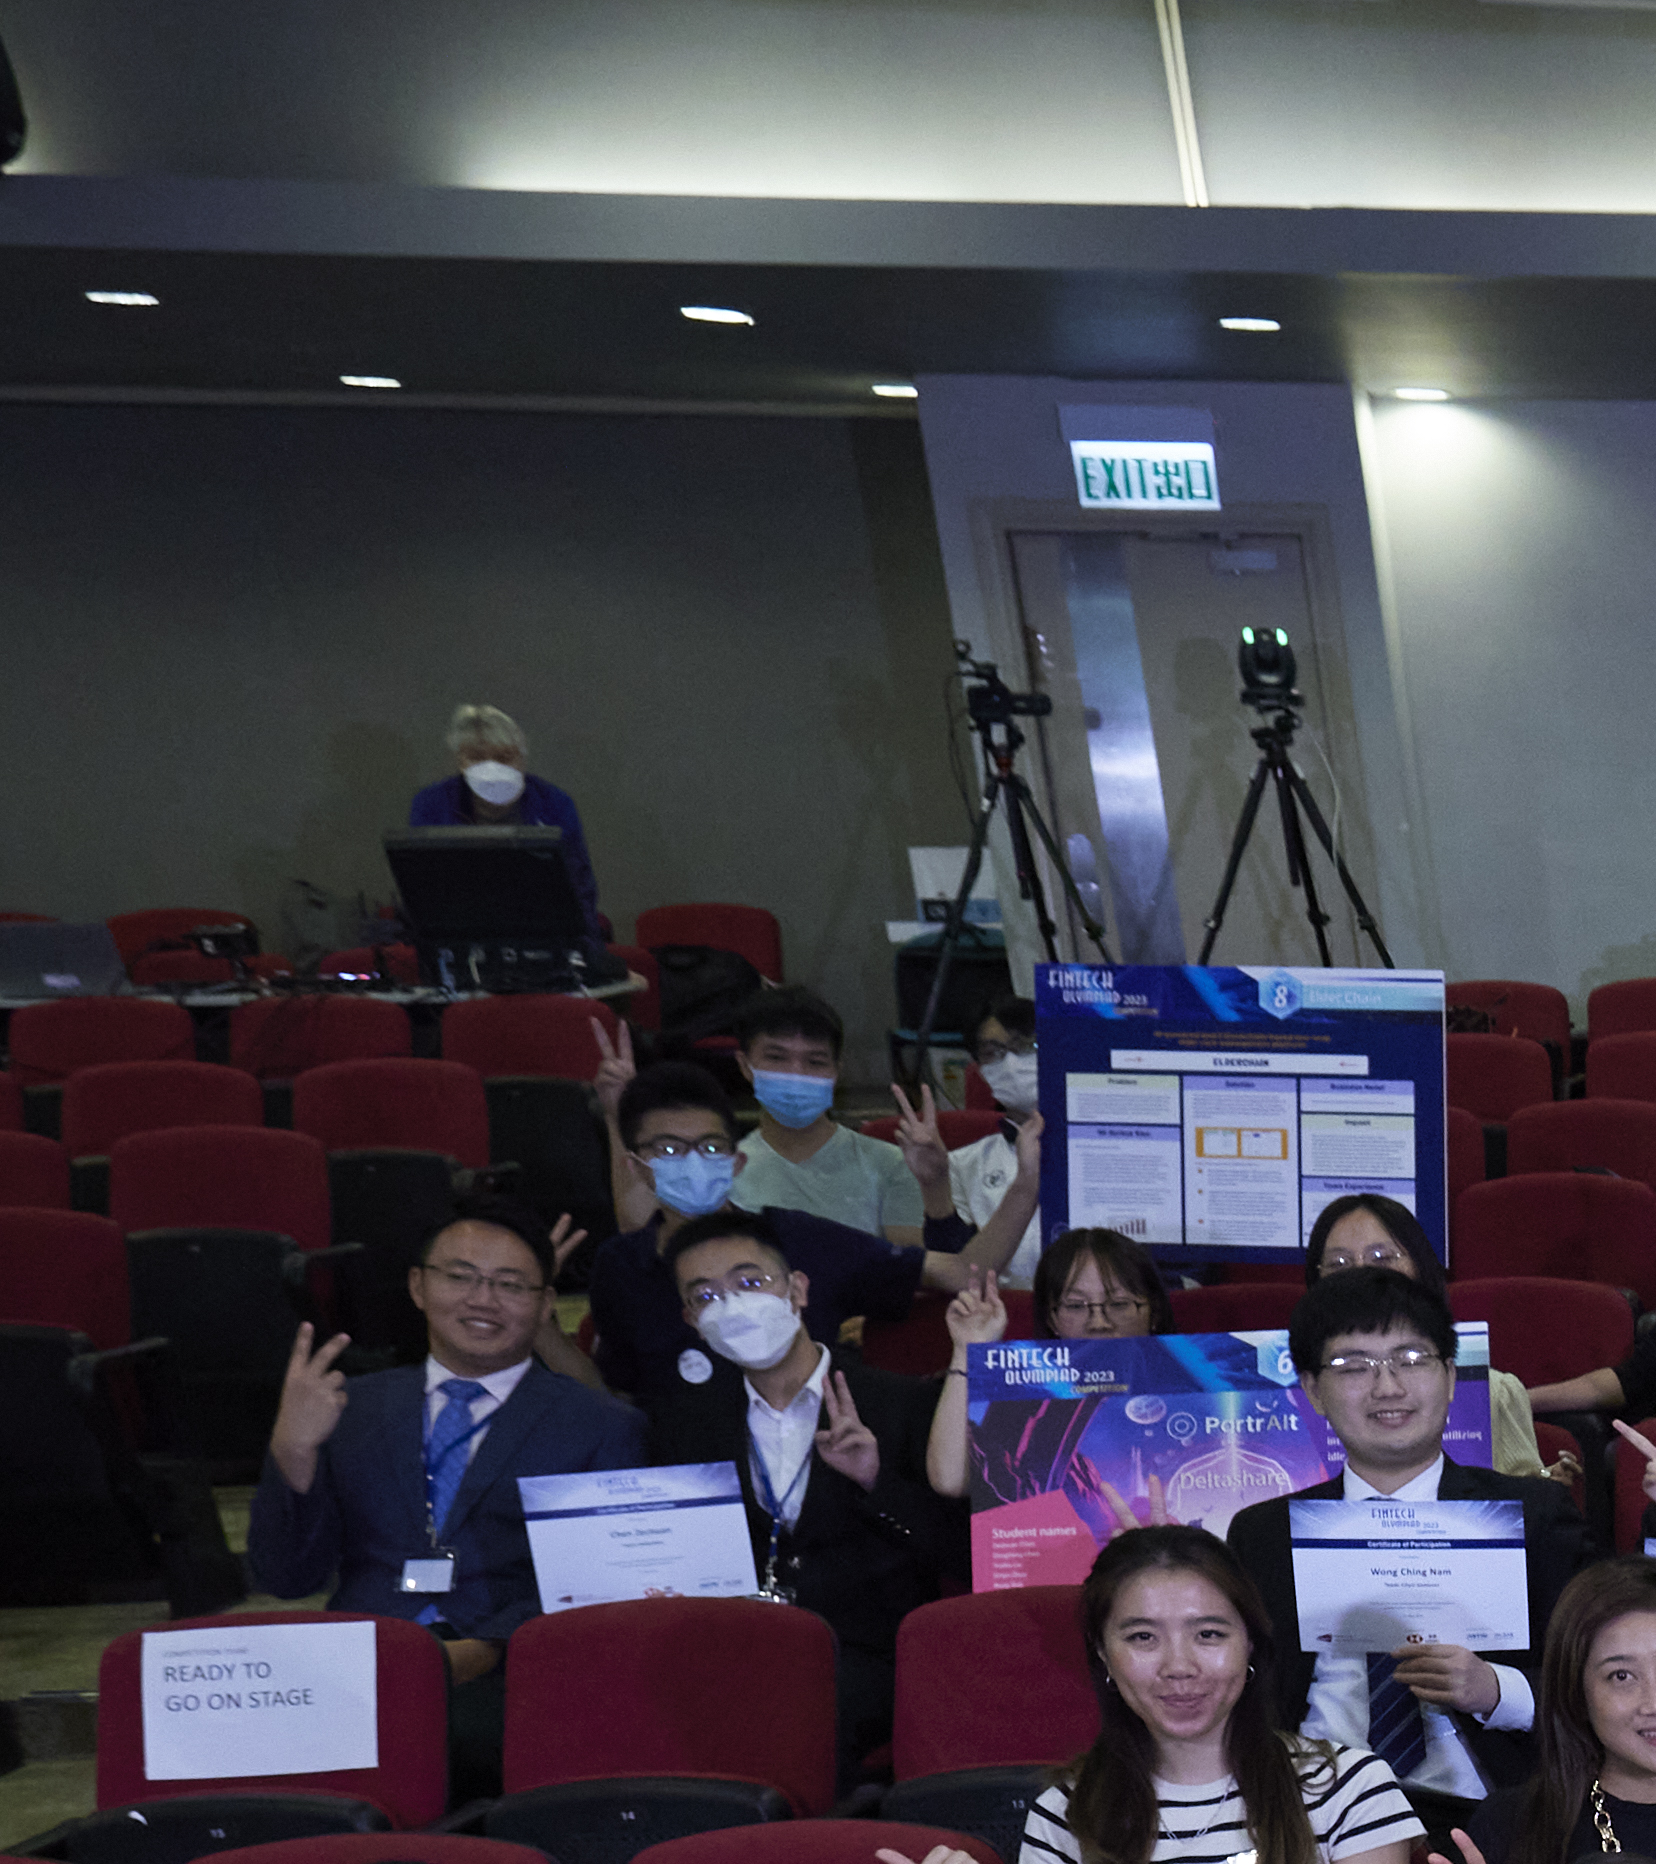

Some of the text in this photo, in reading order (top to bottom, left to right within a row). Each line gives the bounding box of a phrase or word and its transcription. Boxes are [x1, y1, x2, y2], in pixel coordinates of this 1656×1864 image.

[1080, 457, 1148, 499] EXIT
[1153, 459, 1213, 500] 出口
[1048, 969, 1114, 990] FINTECH
[1123, 995, 1148, 1006] 2023
[1273, 984, 1287, 1009] 8
[983, 1346, 1070, 1370] FINTECH
[1277, 1356, 1294, 1376] 6
[1004, 1366, 1115, 1386] OLYMPIAD 2023
[1071, 1382, 1128, 1394] COMPETITION
[1180, 1467, 1287, 1491] Deltashare
[1371, 1507, 1416, 1520] FINTECH
[991, 1526, 1077, 1539] Student names
[1367, 1540, 1401, 1548] Certificate
[1410, 1540, 1452, 1549] Participation
[1370, 1567, 1452, 1577] Wong Ching Nam
[163, 1661, 273, 1684] READY TO
[164, 1687, 315, 1713] GO ON STAGE
